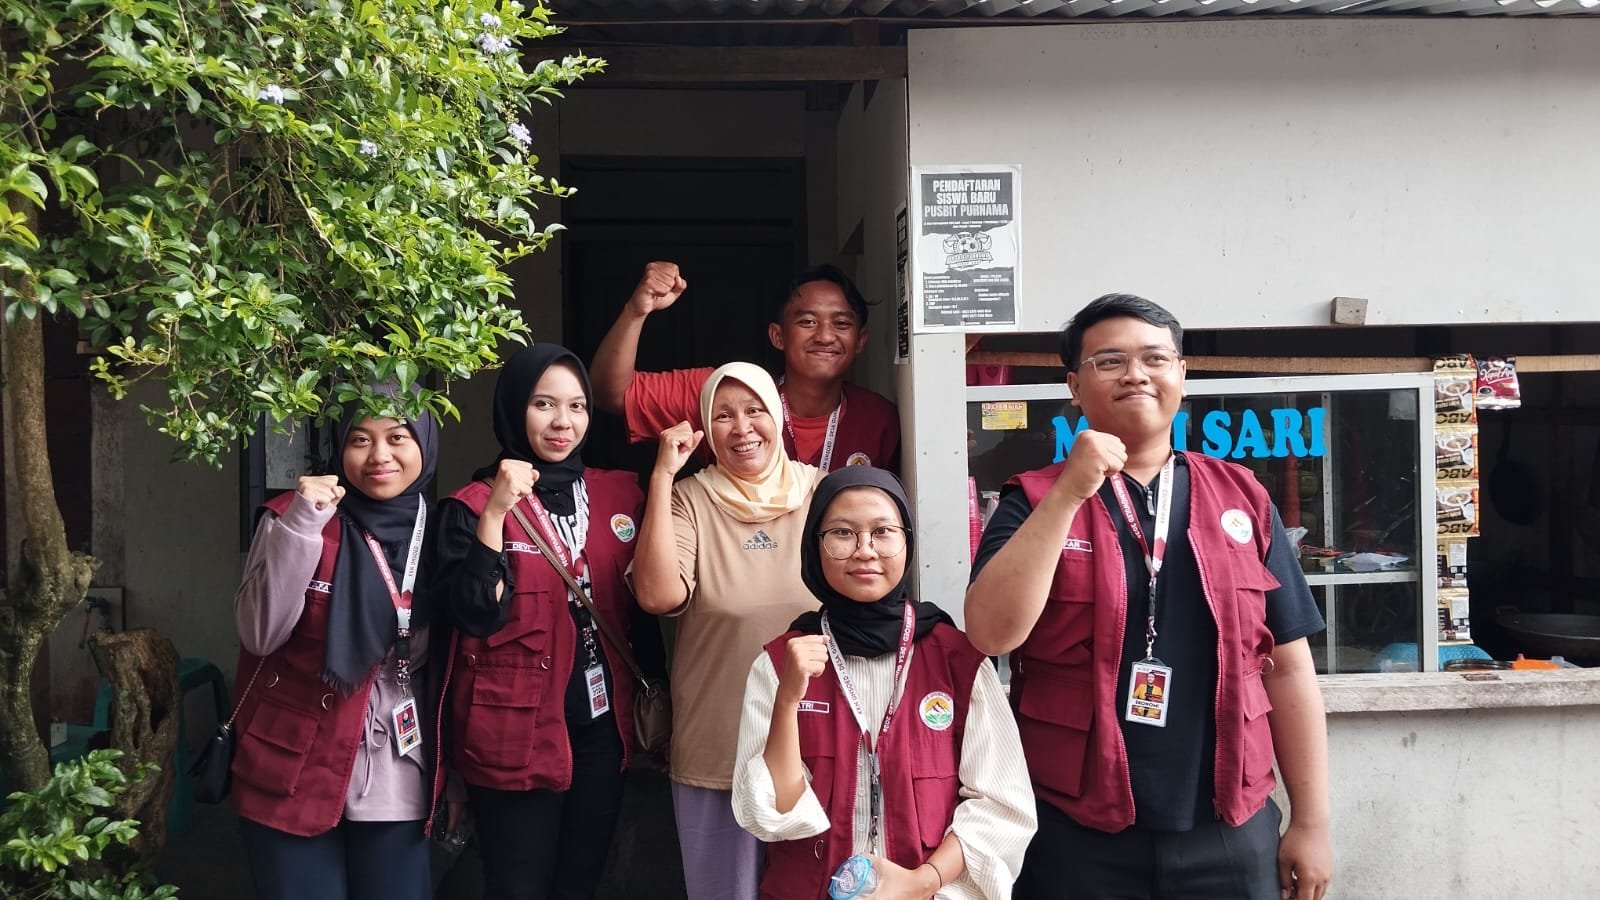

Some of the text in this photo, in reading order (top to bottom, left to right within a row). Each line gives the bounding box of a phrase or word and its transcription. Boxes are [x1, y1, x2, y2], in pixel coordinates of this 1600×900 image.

[932, 179, 1001, 192] PENDAFTARAN
[936, 191, 997, 205] SISWA BARU
[924, 203, 1009, 217] PUSBIT PURNAMA
[1436, 413, 1472, 424] ABC
[1202, 407, 1328, 460] SARI
[1437, 468, 1473, 479] ABC
[1437, 523, 1474, 534] ABC
[743, 541, 778, 550] adidas
